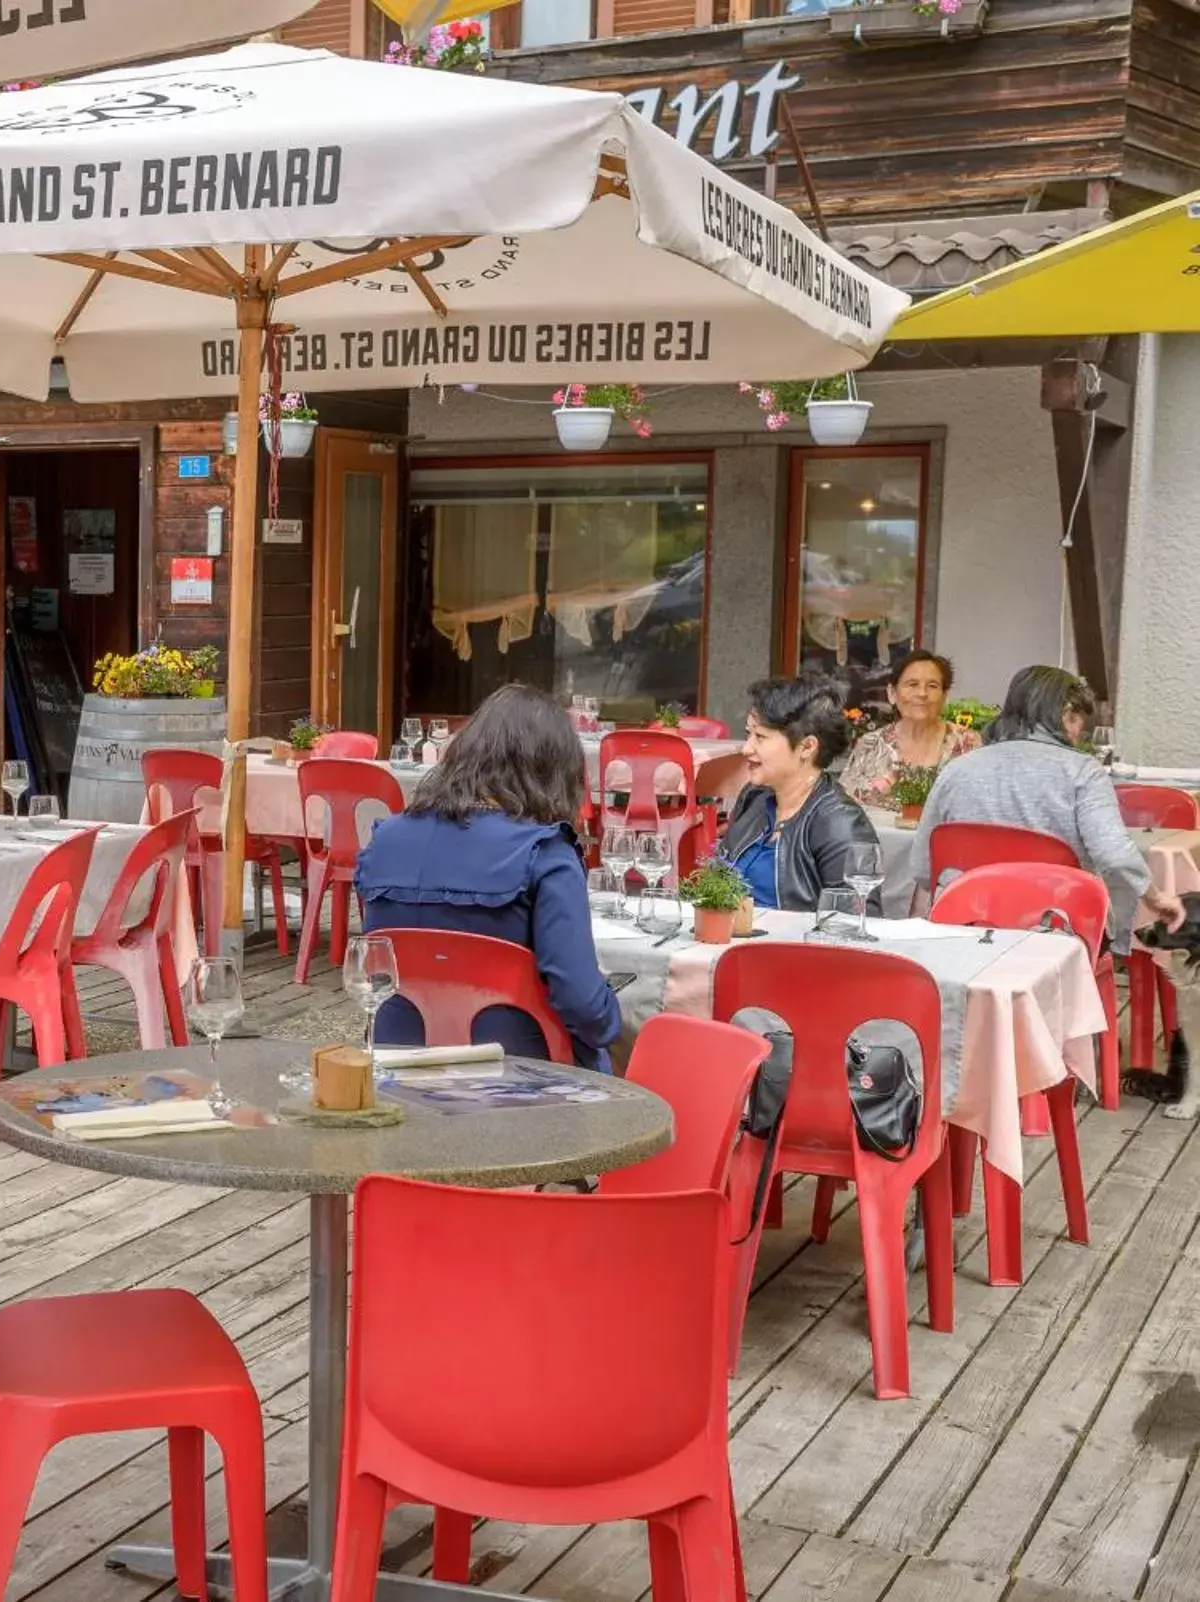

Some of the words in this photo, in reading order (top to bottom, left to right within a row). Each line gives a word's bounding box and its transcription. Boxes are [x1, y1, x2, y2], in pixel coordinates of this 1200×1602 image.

[72, 162, 129, 221] ST.
[140, 145, 342, 216] BERNARD
[702, 176, 724, 243] LES
[725, 192, 764, 268] BIERES
[765, 219, 780, 277] DU
[780, 229, 814, 298] GRAND
[829, 262, 872, 329] BERNARD
